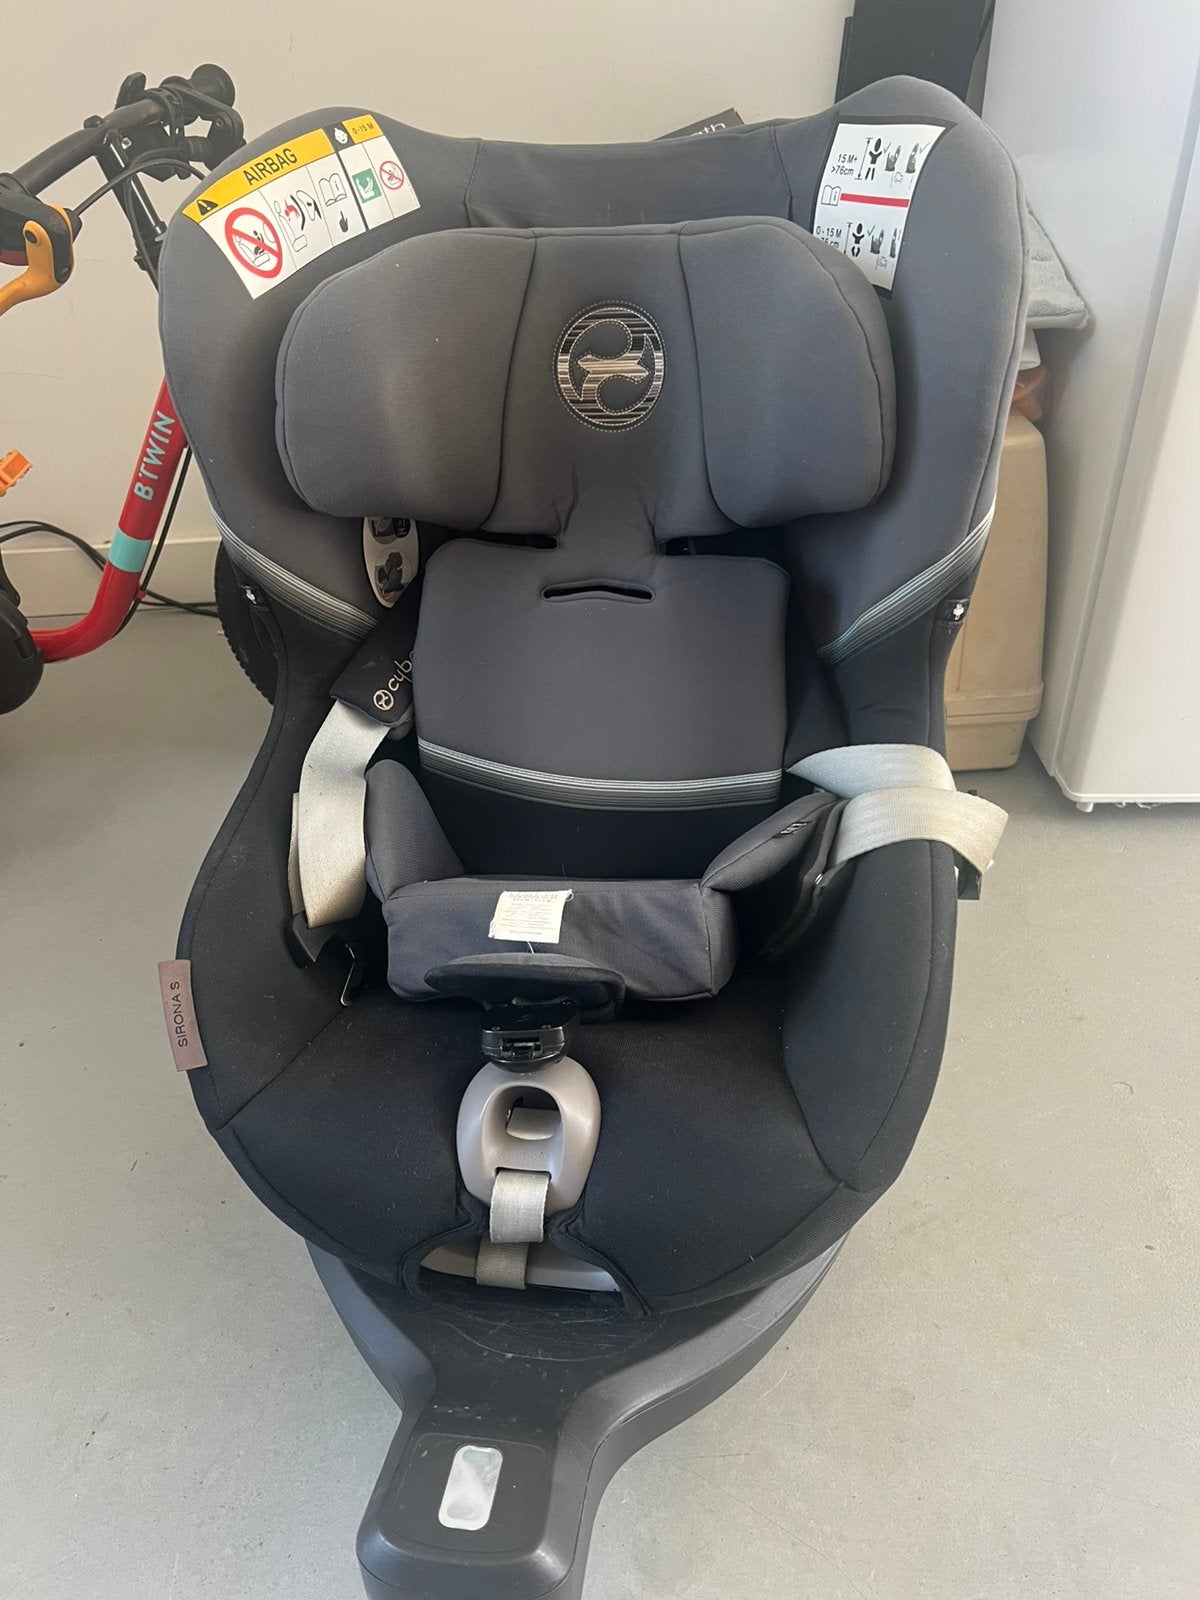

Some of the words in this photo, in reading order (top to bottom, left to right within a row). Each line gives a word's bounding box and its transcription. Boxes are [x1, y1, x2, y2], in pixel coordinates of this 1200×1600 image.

[838, 154, 847, 164] 15
[243, 148, 298, 186] AIRBAG
[826, 227, 835, 238] 15
[835, 228, 842, 238] M
[170, 981, 180, 990] S
[172, 993, 188, 1047] SIRONA
